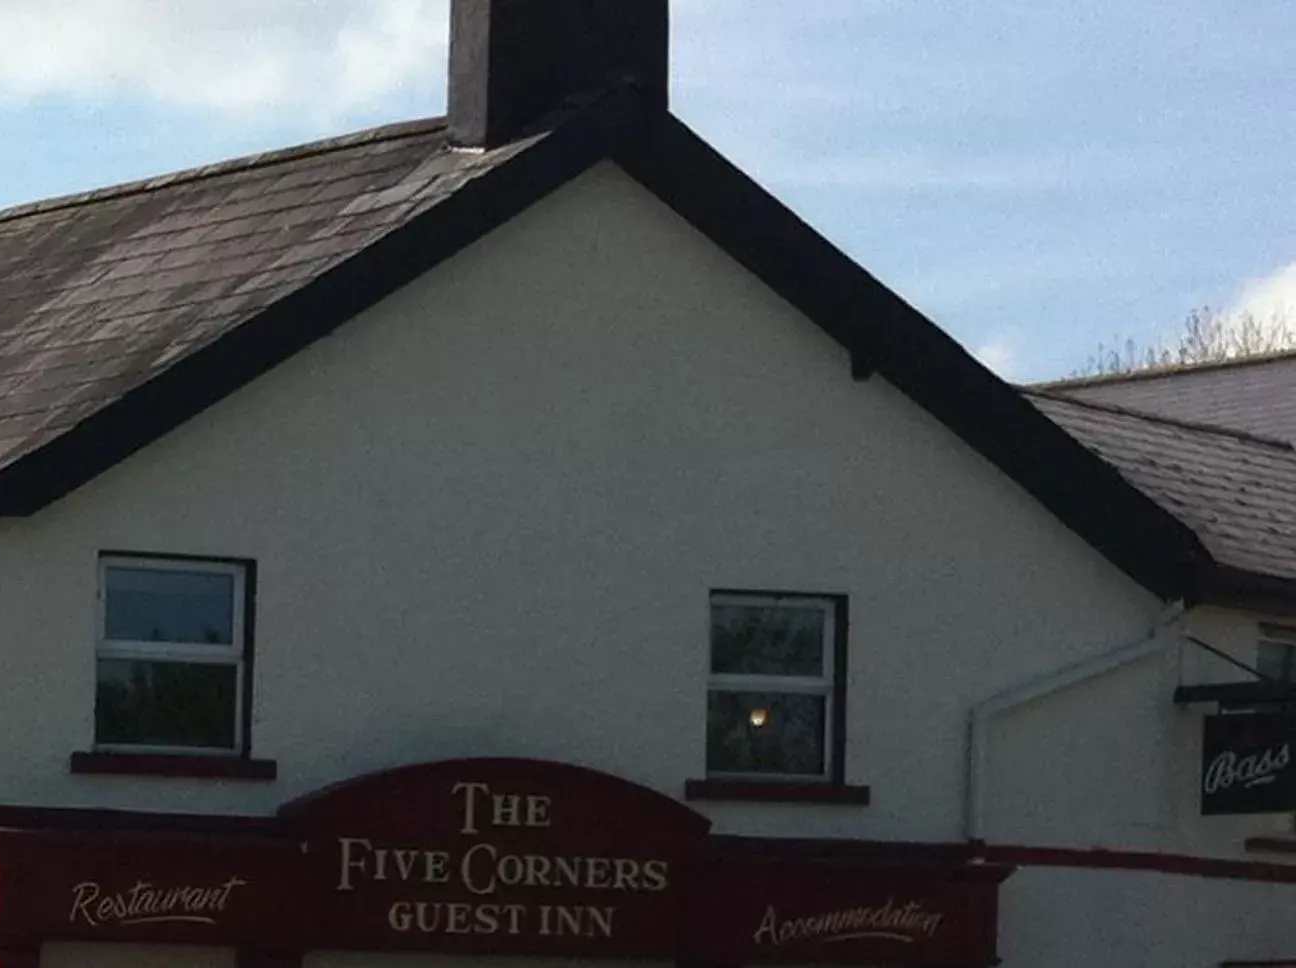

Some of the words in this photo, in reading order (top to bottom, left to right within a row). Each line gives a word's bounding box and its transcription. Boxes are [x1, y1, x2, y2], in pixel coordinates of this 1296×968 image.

[1204, 743, 1291, 795] Bass
[452, 781, 552, 835] THE
[336, 836, 450, 890] FIVE
[460, 843, 669, 895] CORNERS
[69, 872, 252, 927] Restaurant
[388, 901, 526, 934] GUEST
[538, 904, 617, 937] INN
